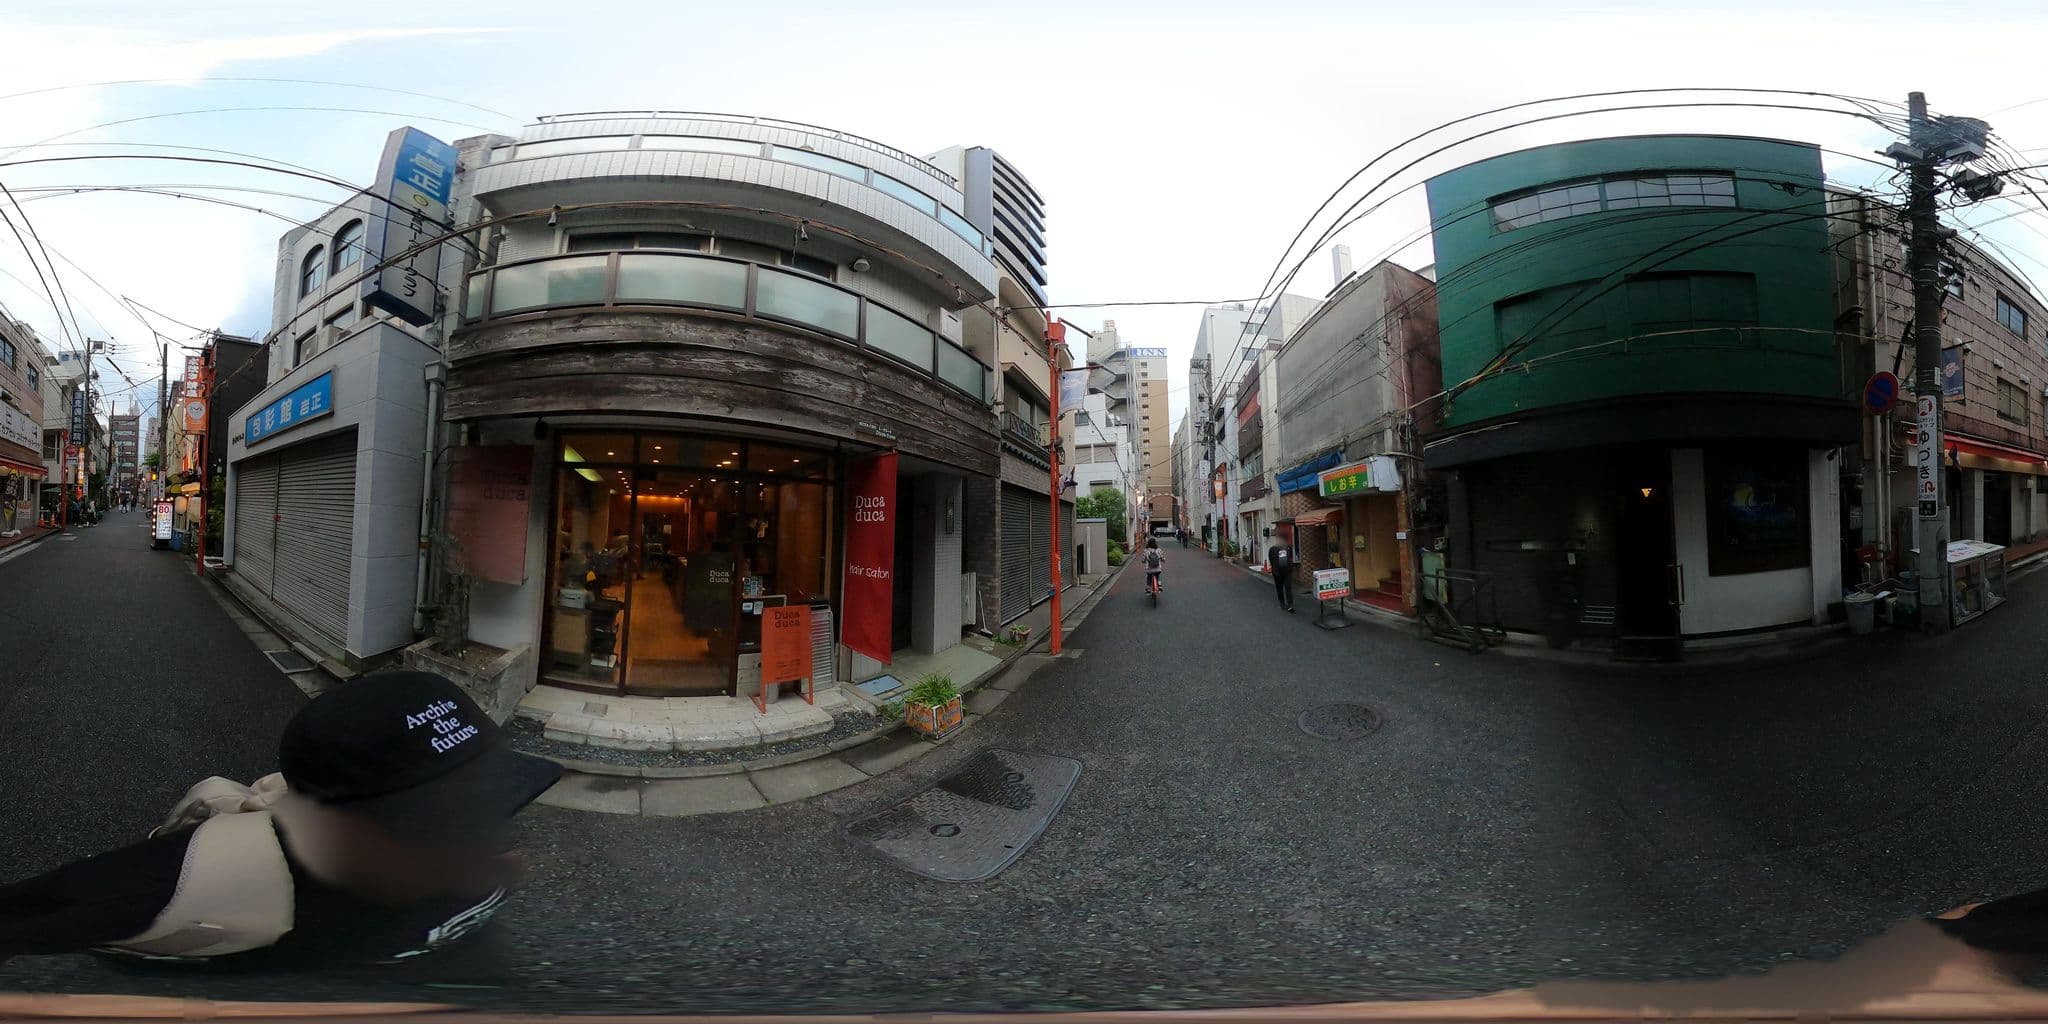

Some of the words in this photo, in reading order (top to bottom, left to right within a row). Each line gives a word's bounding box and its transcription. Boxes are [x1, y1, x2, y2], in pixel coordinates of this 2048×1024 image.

[1919, 430, 1930, 479] ゆづき
[855, 496, 885, 509] Duca
[855, 509, 885, 521] duca
[849, 562, 864, 577] hair
[774, 611, 801, 620] Duca
[774, 619, 801, 628] duca
[433, 717, 460, 734] the
[431, 725, 478, 753] future
